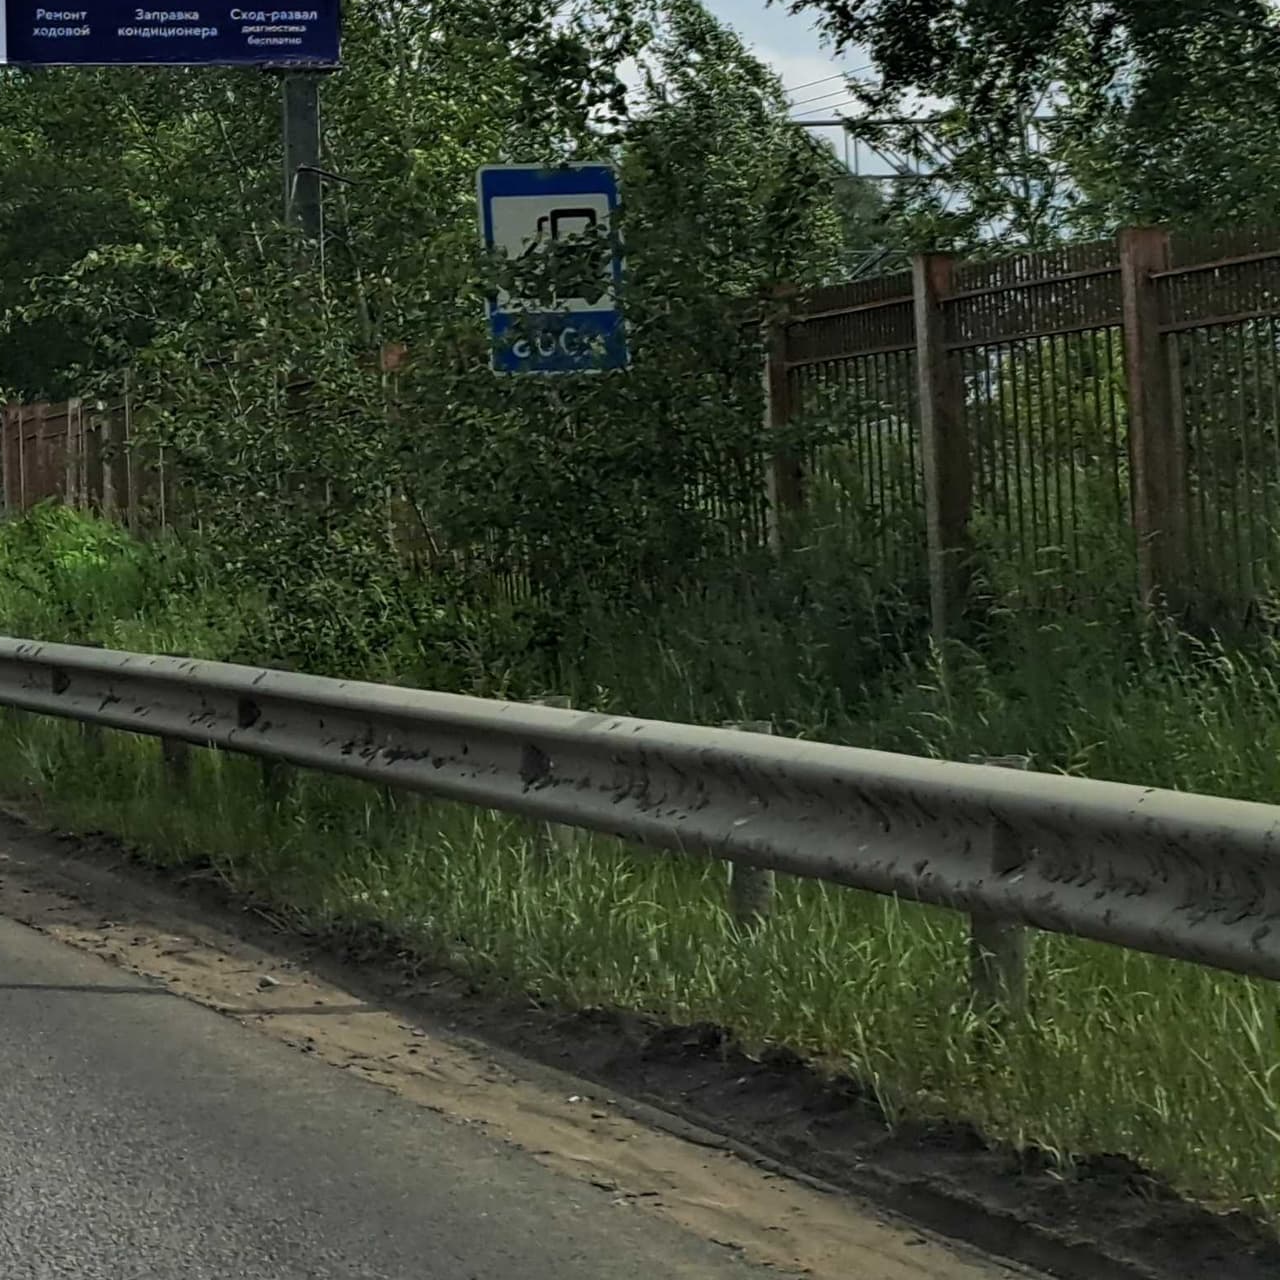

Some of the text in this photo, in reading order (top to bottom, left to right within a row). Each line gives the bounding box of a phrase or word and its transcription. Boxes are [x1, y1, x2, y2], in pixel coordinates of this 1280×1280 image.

[35, 8, 88, 21] Ремонт
[134, 8, 200, 23] Заправка
[229, 7, 318, 22] Сход-развал
[32, 25, 91, 37] ходовой
[117, 26, 218, 39] кондиционера
[247, 35, 303, 46] бесплатно
